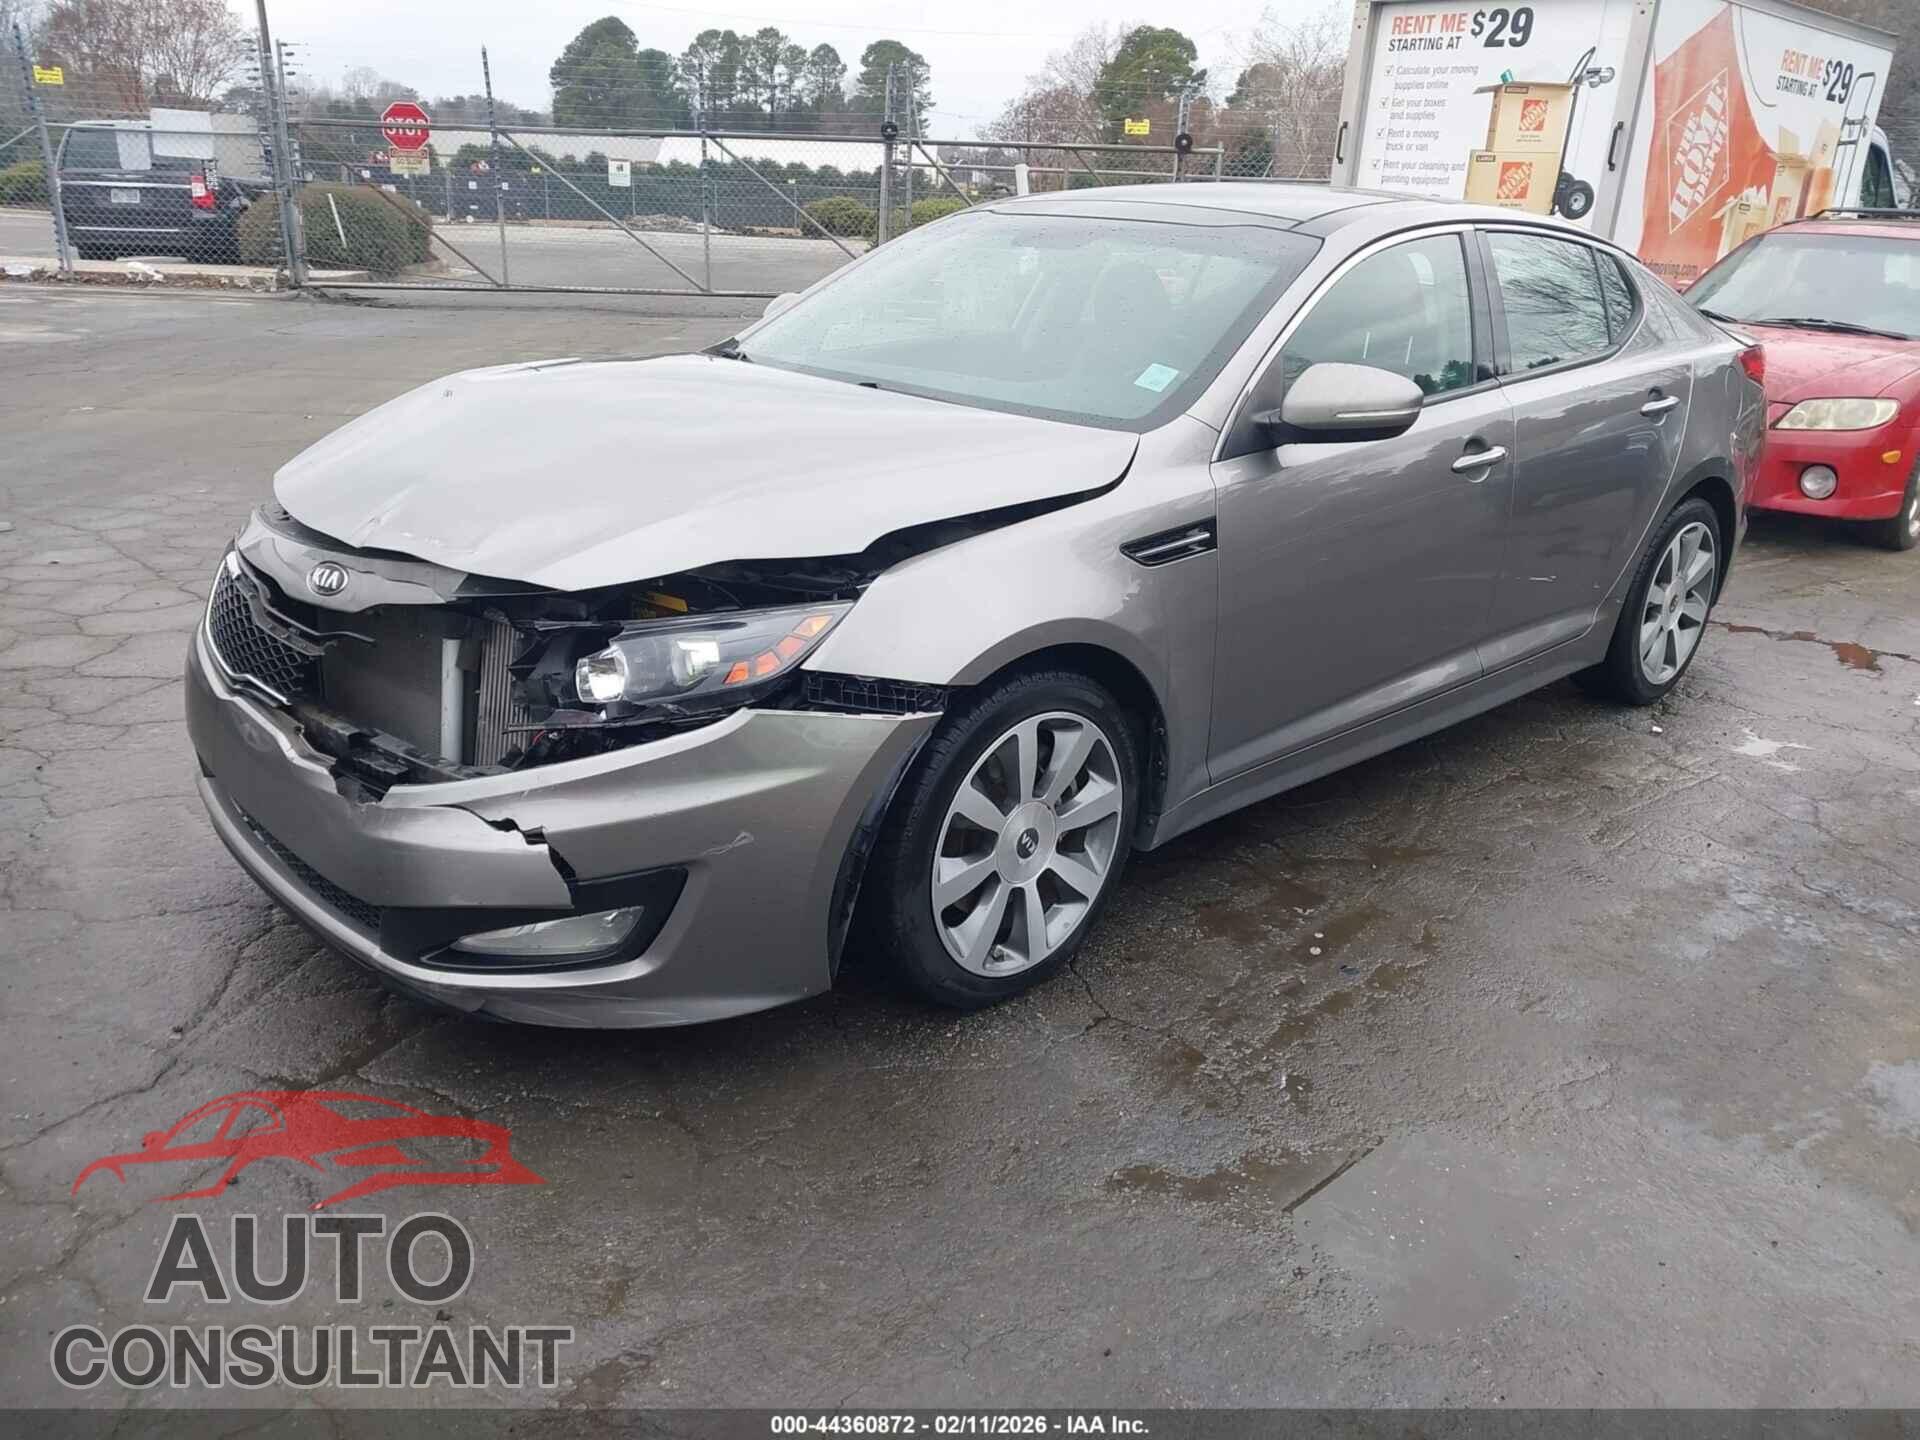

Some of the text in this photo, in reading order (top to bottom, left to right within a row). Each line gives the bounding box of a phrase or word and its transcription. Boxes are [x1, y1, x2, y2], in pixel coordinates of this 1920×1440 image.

[1392, 7, 1534, 48] RENT ME $29
[1388, 36, 1462, 52] STARTING AT
[1396, 65, 1479, 76] Calculate your moving
[1780, 49, 1853, 104] RENT ME $29
[1426, 81, 1448, 89] online
[1776, 75, 1817, 98] STARTING AT
[1391, 97, 1446, 109] Get your boxes
[1390, 111, 1436, 120] and supplies
[386, 117, 426, 136] STOP
[1387, 128, 1404, 138] Rent
[1412, 129, 1439, 140] moving
[1674, 112, 1699, 166] THE
[1385, 142, 1403, 151] truck
[1416, 143, 1429, 151] van
[1671, 79, 1728, 222] HOME
[1383, 160, 1400, 169] Rent
[1401, 161, 1416, 171] your
[1418, 160, 1449, 172] cleaning
[1381, 175, 1450, 186] painting equipment
[312, 567, 340, 590] KIA
